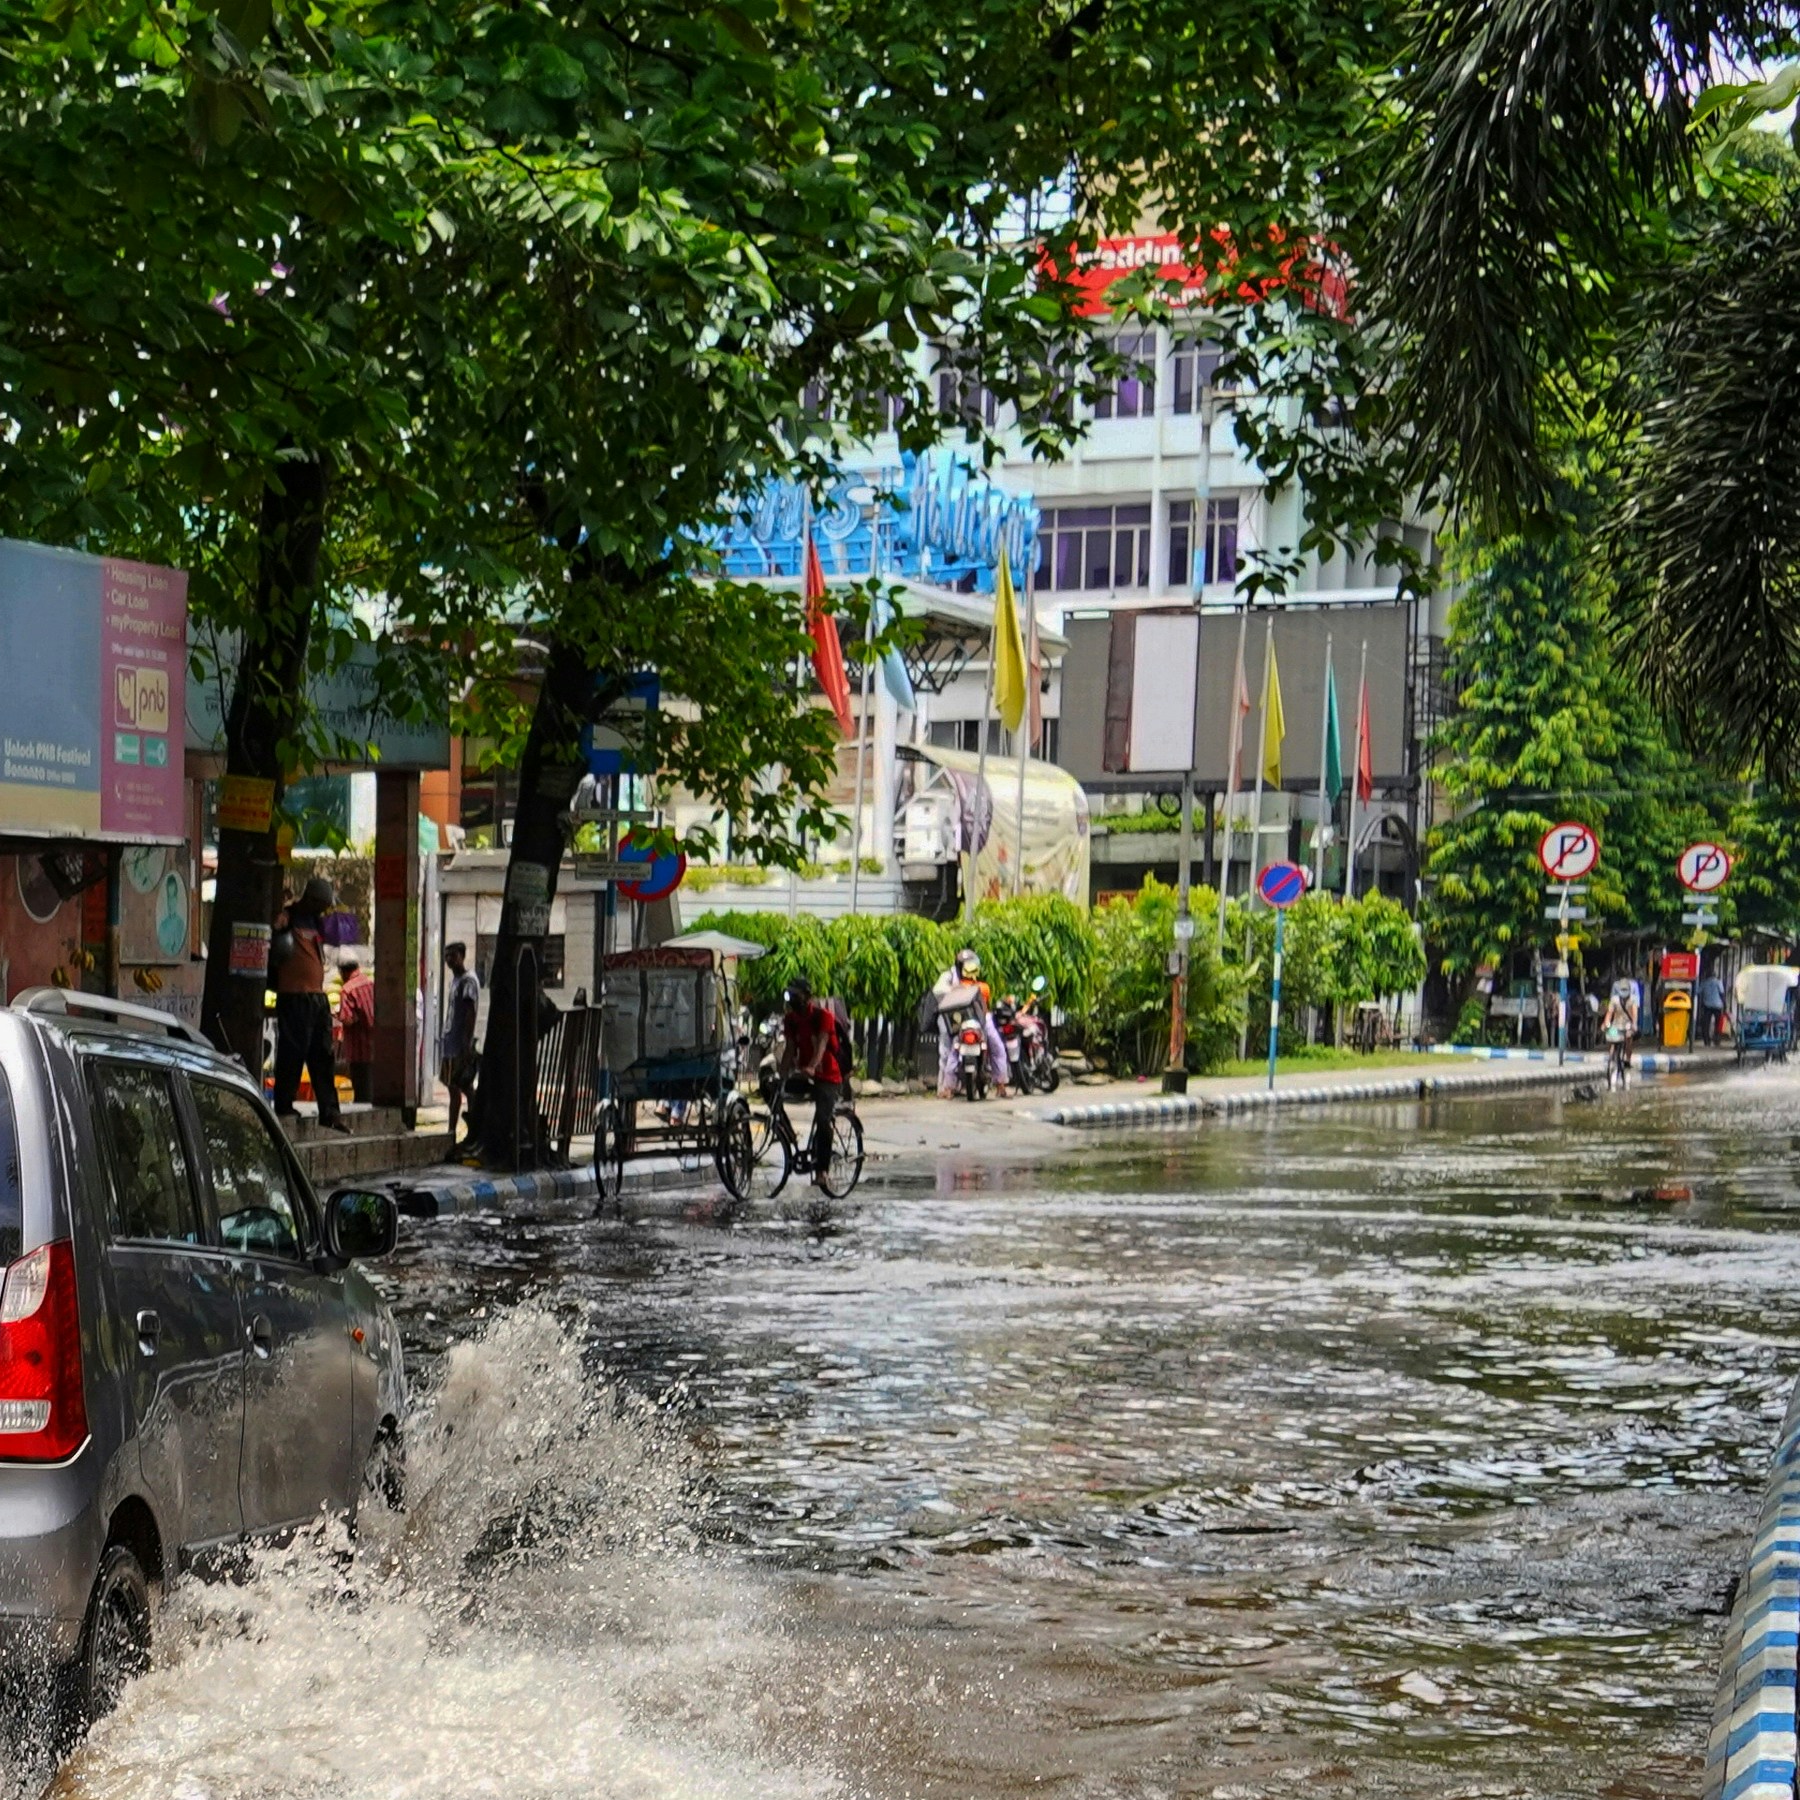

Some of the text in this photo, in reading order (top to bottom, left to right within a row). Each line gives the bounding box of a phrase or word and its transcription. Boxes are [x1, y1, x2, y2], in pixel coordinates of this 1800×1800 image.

[139, 677, 166, 721] pnb
[4, 737, 35, 760] Unlock
[57, 744, 91, 768] Festival
